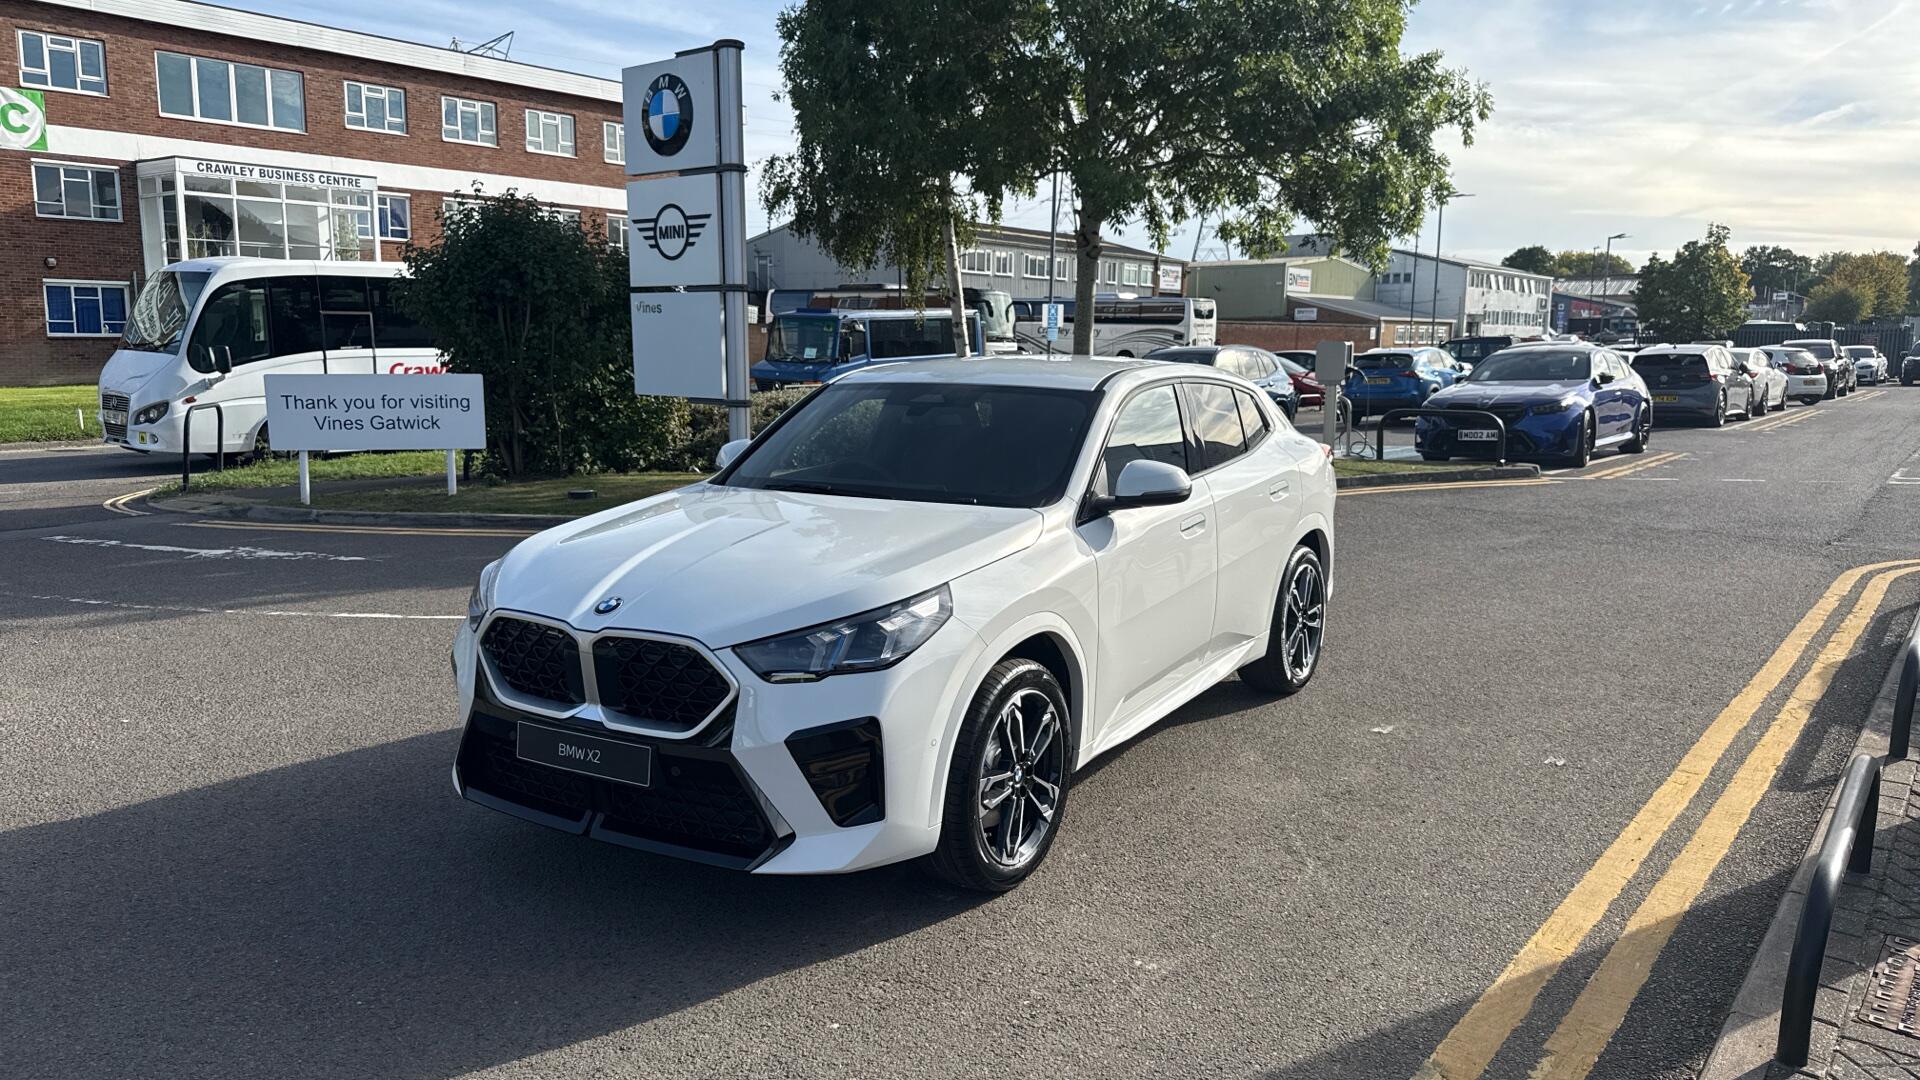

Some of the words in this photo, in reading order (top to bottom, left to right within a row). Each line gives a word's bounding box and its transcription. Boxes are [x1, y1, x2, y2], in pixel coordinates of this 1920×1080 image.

[645, 75, 687, 103] BMW
[197, 162, 255, 177] CRAWLEY
[259, 169, 315, 183] BUSINESS
[319, 175, 361, 188] CENTRE
[658, 225, 685, 240] MINI
[281, 394, 338, 410] Thank
[344, 398, 375, 413] you
[381, 394, 405, 409] for
[411, 394, 470, 413] visiting
[314, 415, 364, 431] Vines
[370, 415, 441, 430] Gatwick
[559, 743, 586, 760] BMW
[587, 748, 601, 764] X2
